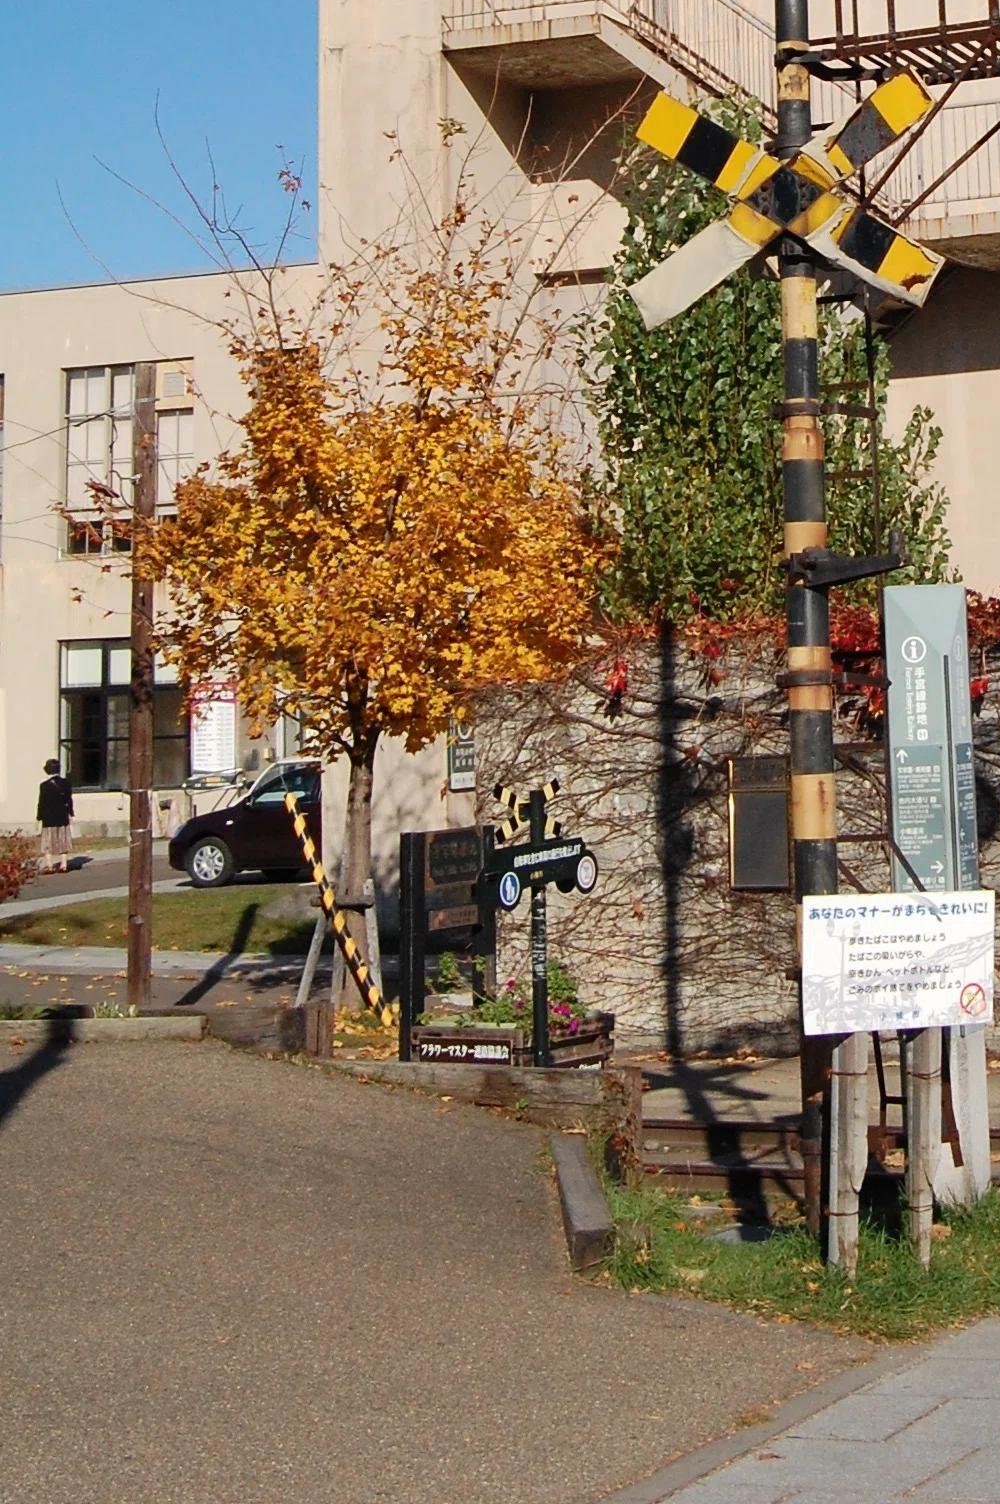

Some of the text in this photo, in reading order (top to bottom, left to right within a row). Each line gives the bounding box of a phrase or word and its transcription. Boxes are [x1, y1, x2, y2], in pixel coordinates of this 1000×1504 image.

[849, 933, 946, 945] 歩きたばこはやめましょう
[848, 980, 962, 995] ごみのポイ捨てをやめましょう
